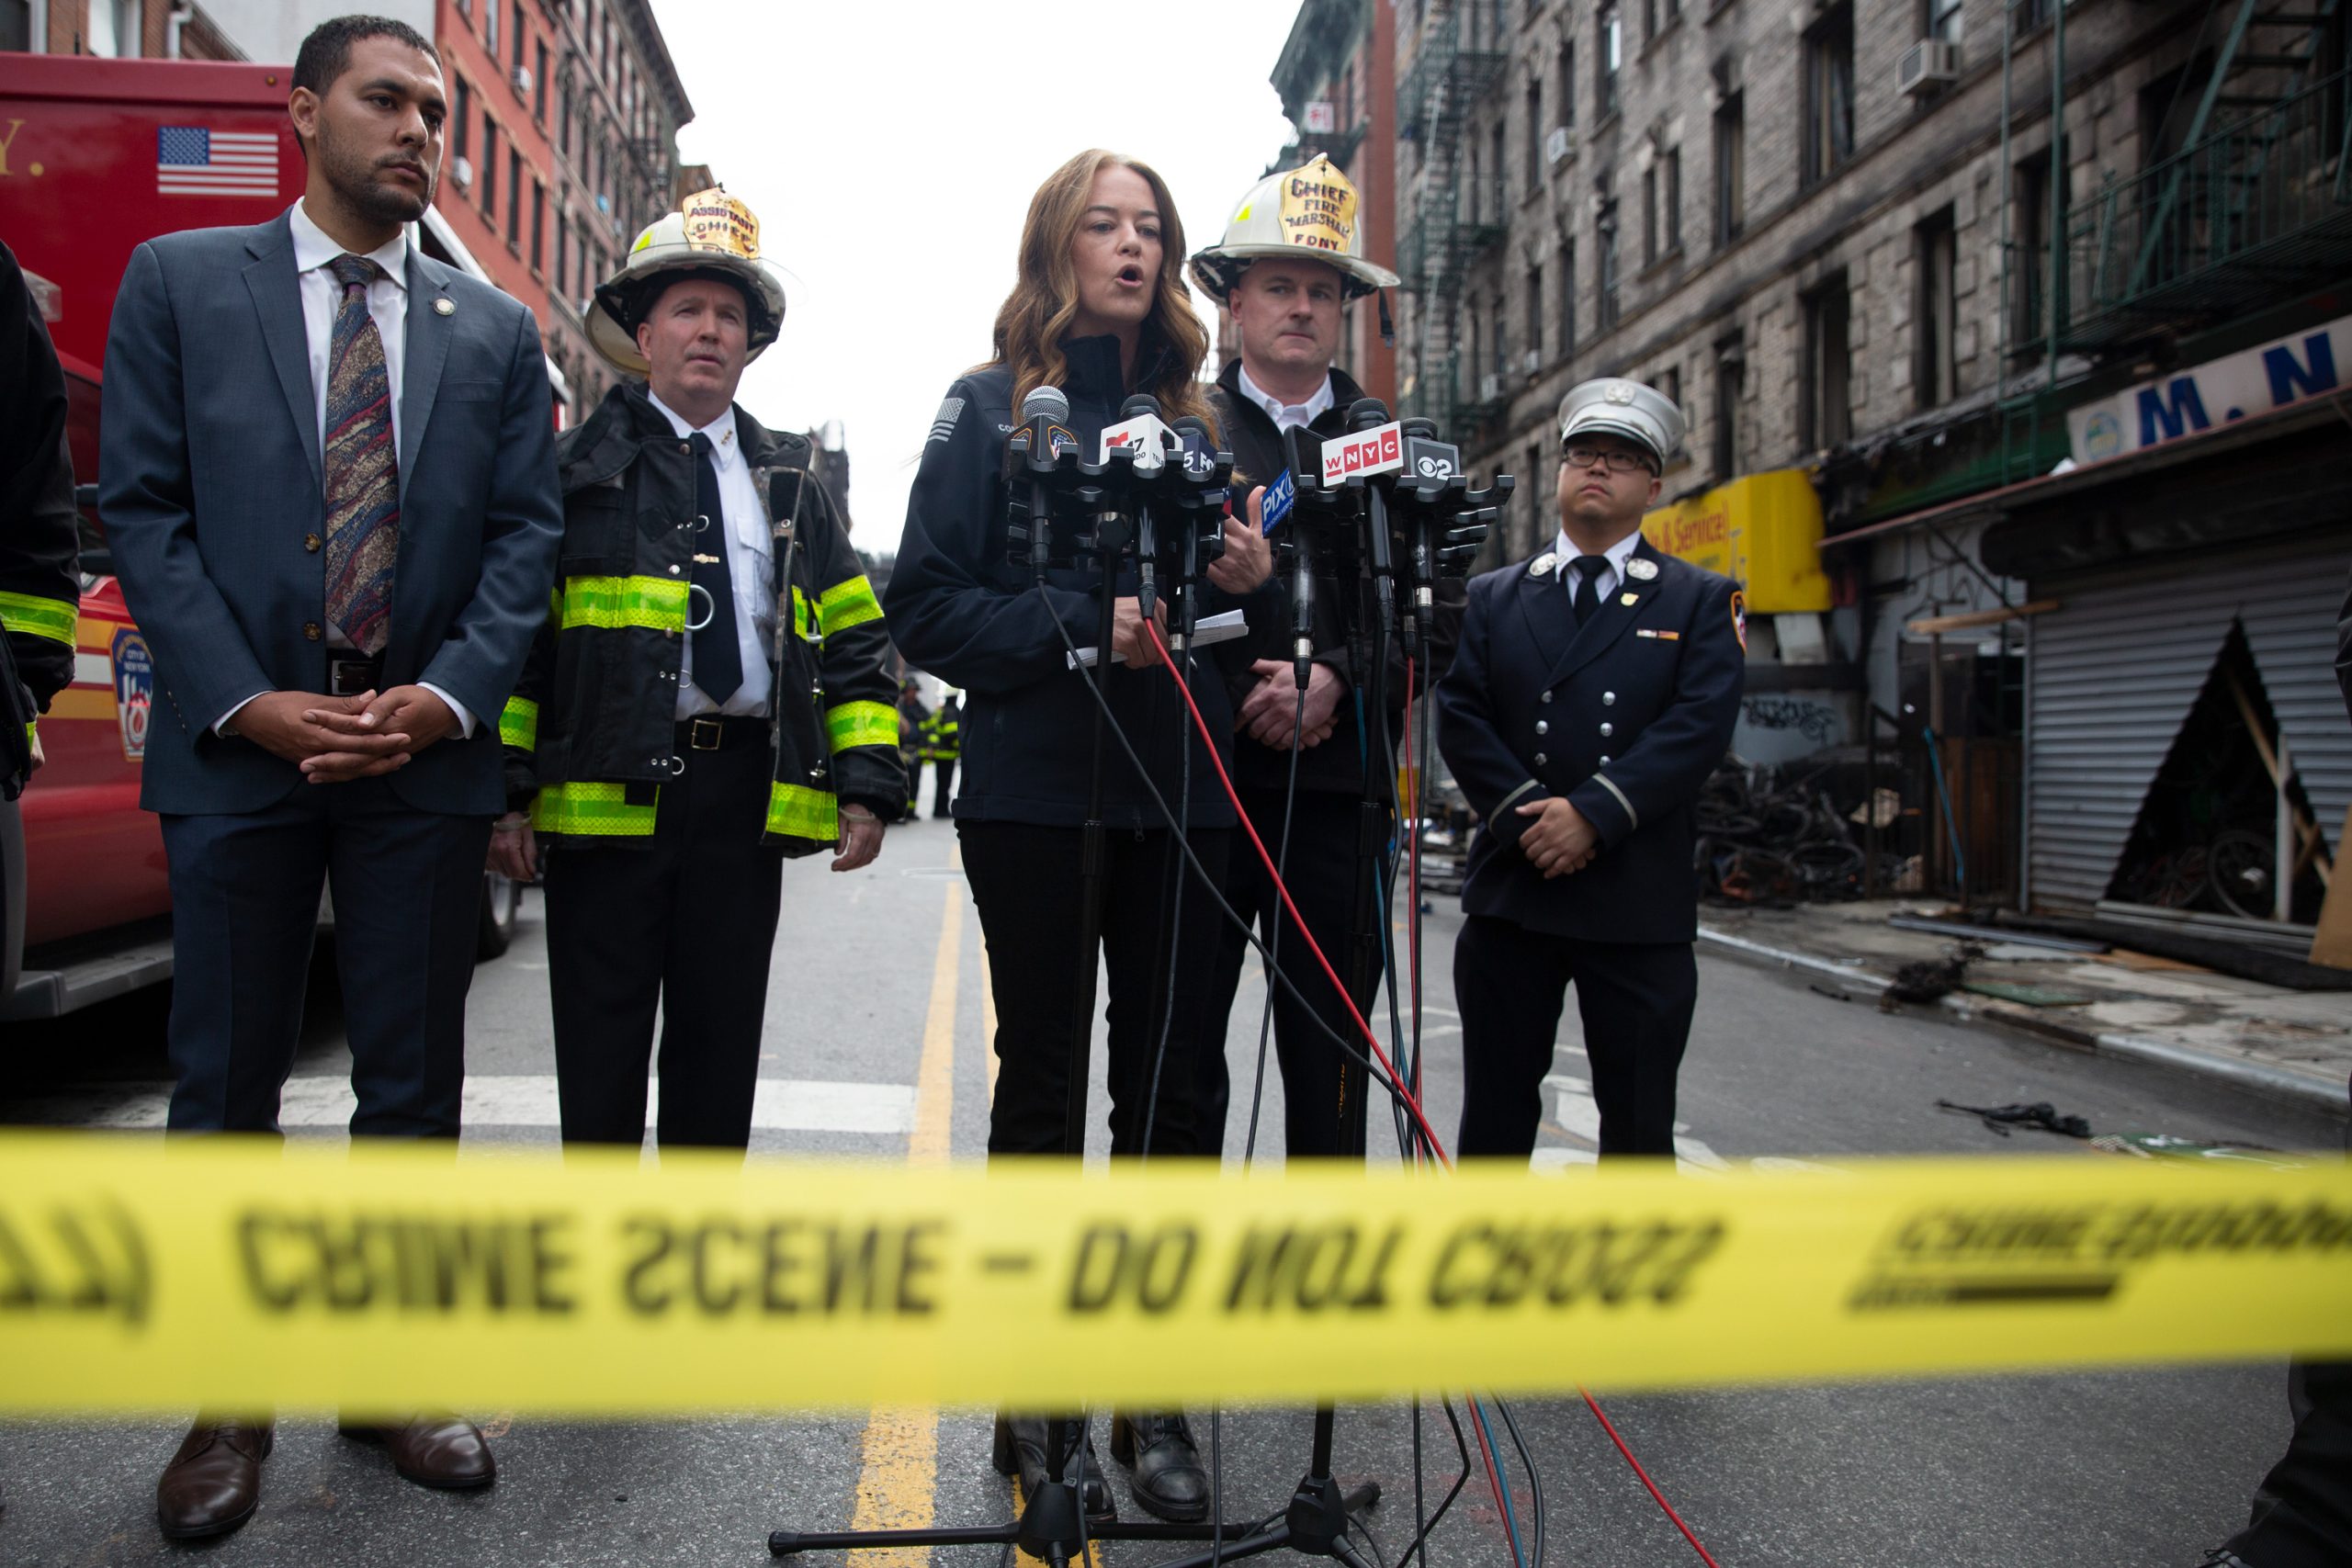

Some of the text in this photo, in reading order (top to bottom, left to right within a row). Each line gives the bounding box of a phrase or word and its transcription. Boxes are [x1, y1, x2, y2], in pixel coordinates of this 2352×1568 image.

[1292, 178, 1349, 206] CHIEF
[689, 207, 754, 234] ASSISTANT
[1305, 199, 1340, 218] FIRE
[1295, 234, 1339, 251] FDNY
[1326, 441, 1396, 469] WNYC
